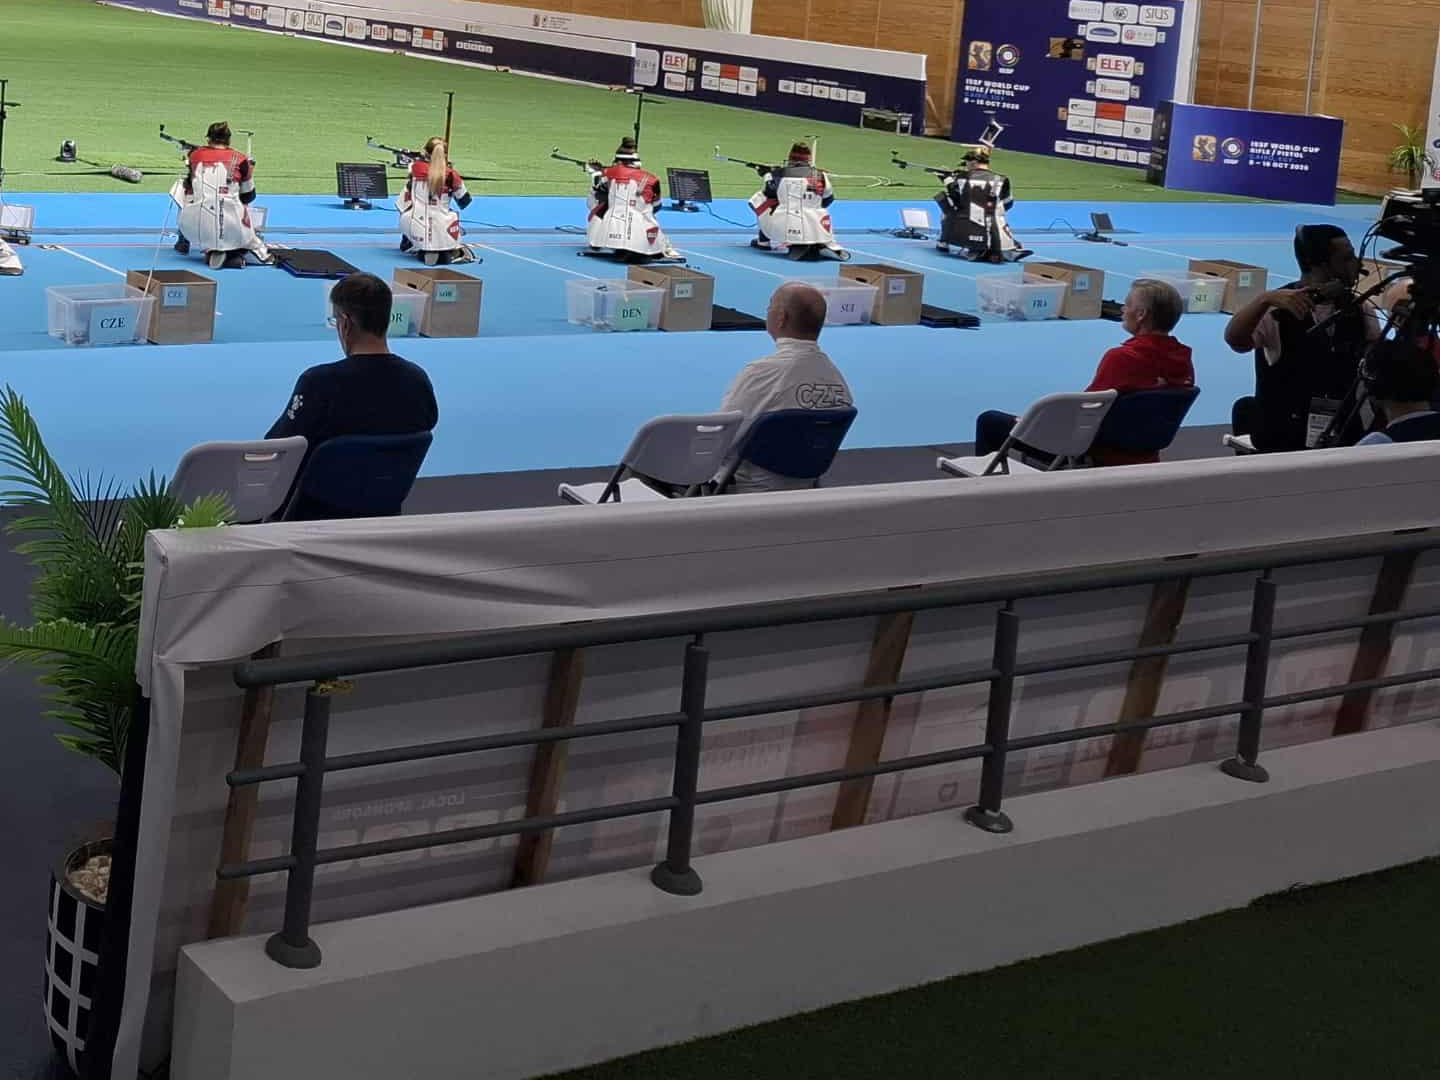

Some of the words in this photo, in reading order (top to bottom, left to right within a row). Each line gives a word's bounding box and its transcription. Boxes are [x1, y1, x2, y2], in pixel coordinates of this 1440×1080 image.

[1145, 8, 1169, 20] SIUS
[665, 55, 686, 69] ELEY
[1101, 58, 1130, 72] ELEY
[983, 80, 1012, 89] WORLD
[1270, 143, 1301, 151] WORLD
[622, 309, 642, 319] DEN
[840, 304, 855, 313] SUI
[100, 316, 126, 329] CZE
[795, 383, 852, 409] CZE
